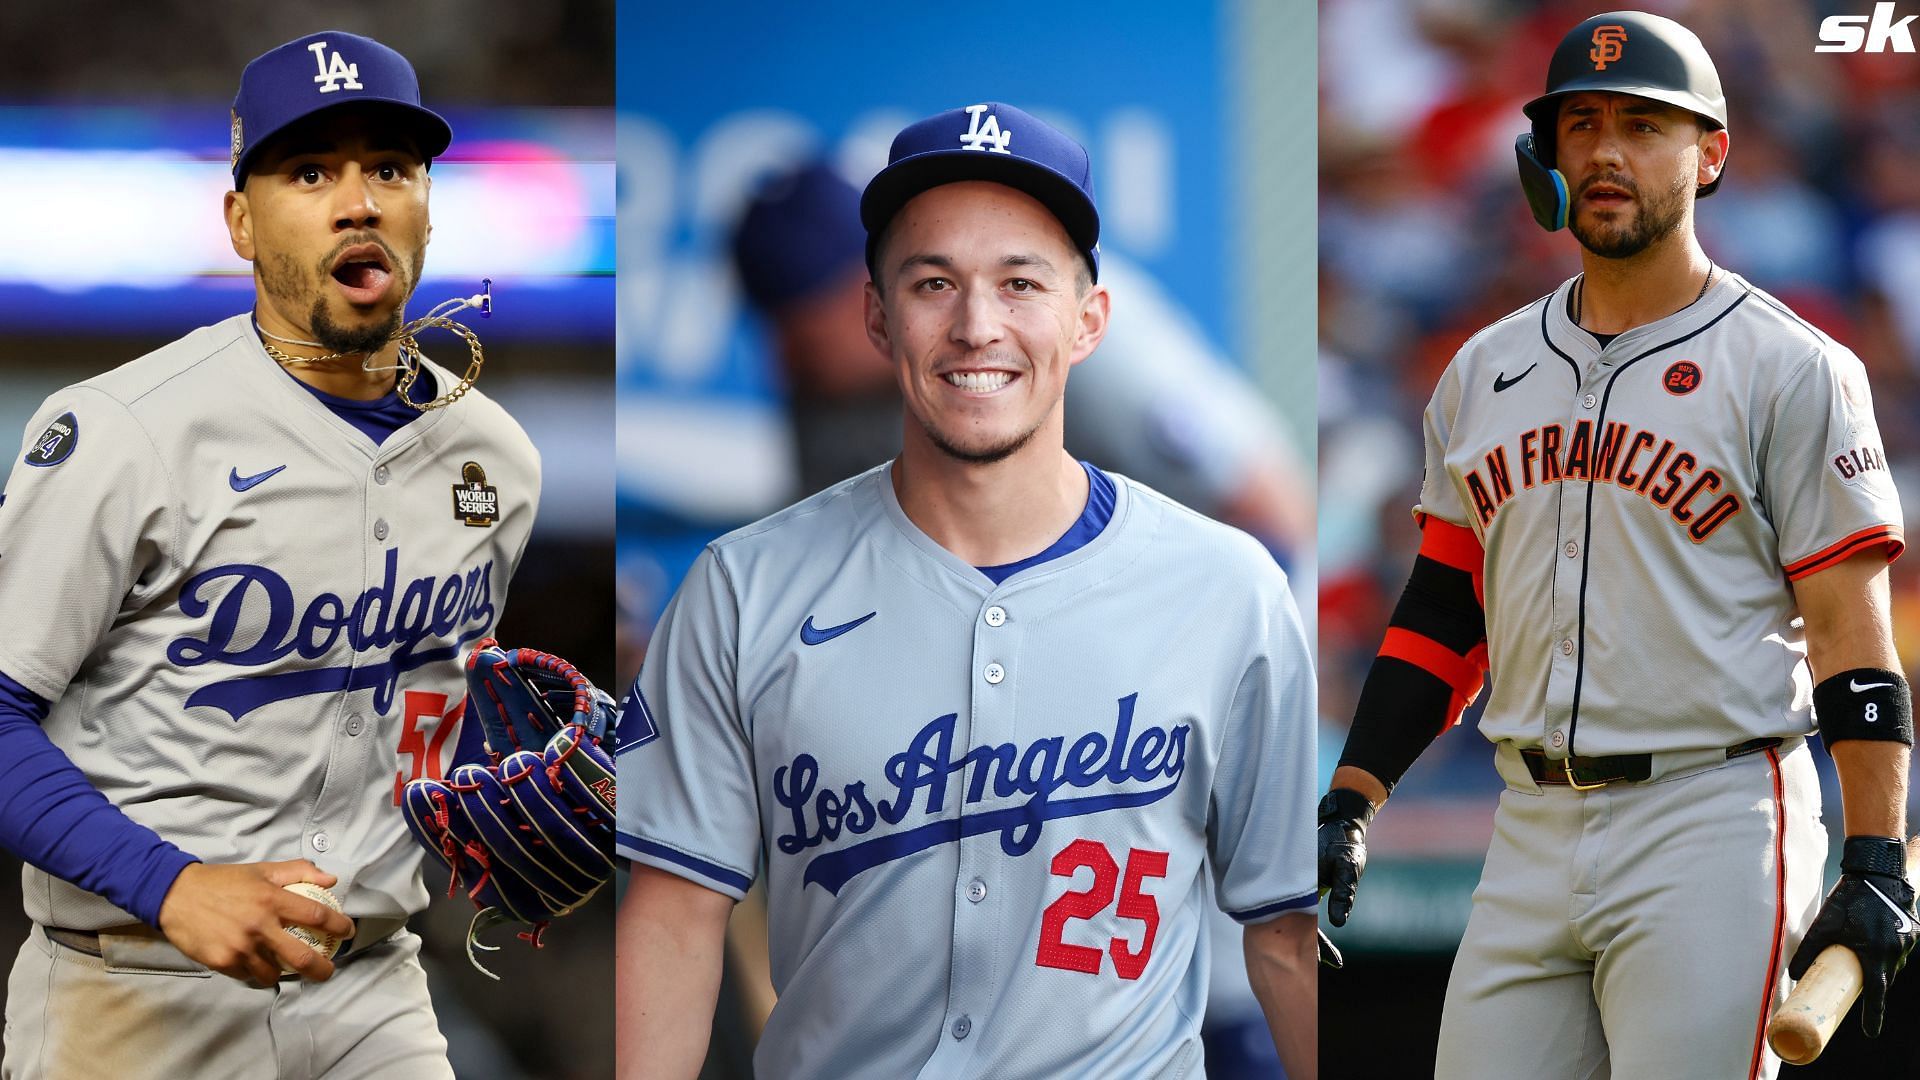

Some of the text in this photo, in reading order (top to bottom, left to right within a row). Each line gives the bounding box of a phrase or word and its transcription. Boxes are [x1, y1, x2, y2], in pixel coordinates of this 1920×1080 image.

[307, 41, 363, 93] LA
[959, 104, 1012, 154] LA
[1668, 371, 1694, 388] 24
[456, 489, 496, 503] WORLD
[459, 500, 496, 515] SERIES
[1519, 419, 1742, 545] FRANCISCO
[166, 547, 495, 717] Dodgers
[1864, 702, 1878, 722] 8
[773, 692, 1191, 857] Los Angeles
[1035, 838, 1170, 981] 25
